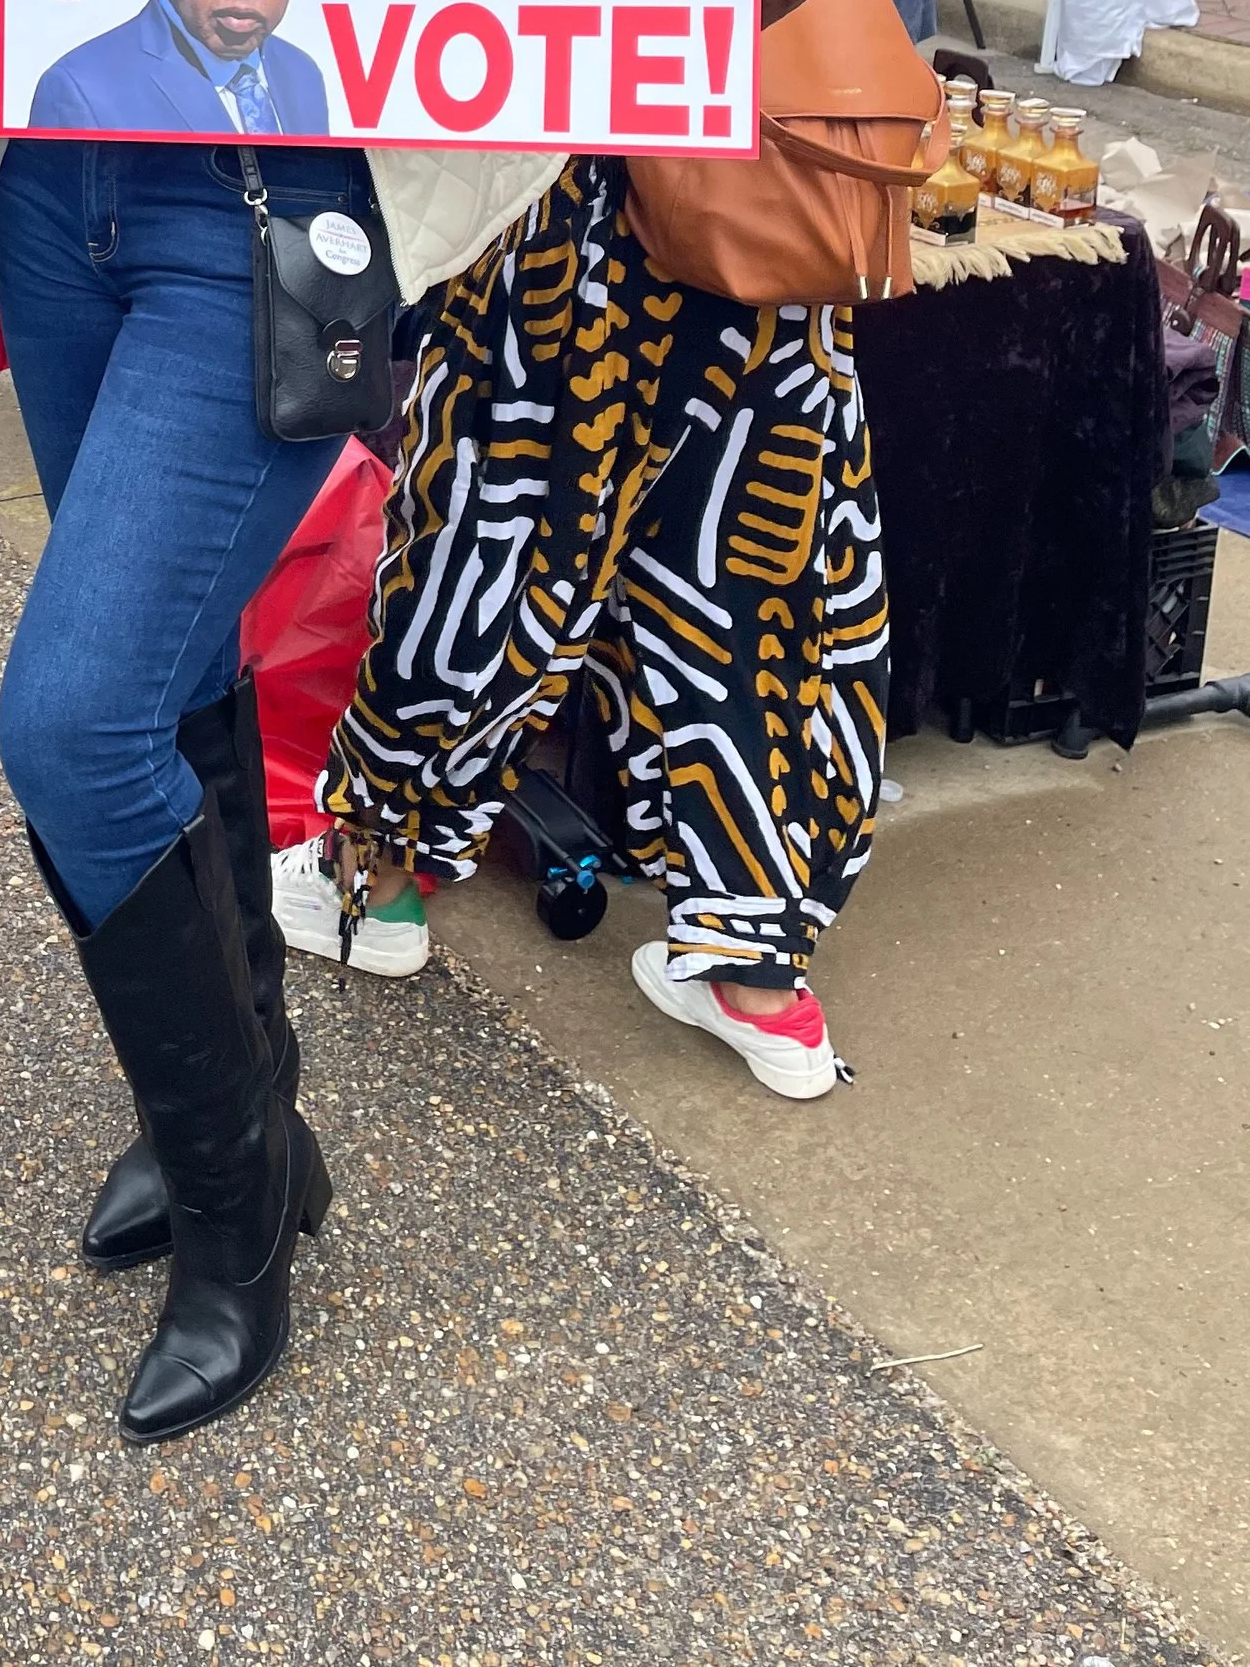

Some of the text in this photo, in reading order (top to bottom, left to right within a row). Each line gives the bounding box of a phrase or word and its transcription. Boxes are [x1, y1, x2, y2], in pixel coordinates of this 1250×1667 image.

[322, 2, 735, 138] VOTE!
[325, 219, 356, 235] JAMES
[325, 249, 361, 266] Congress
